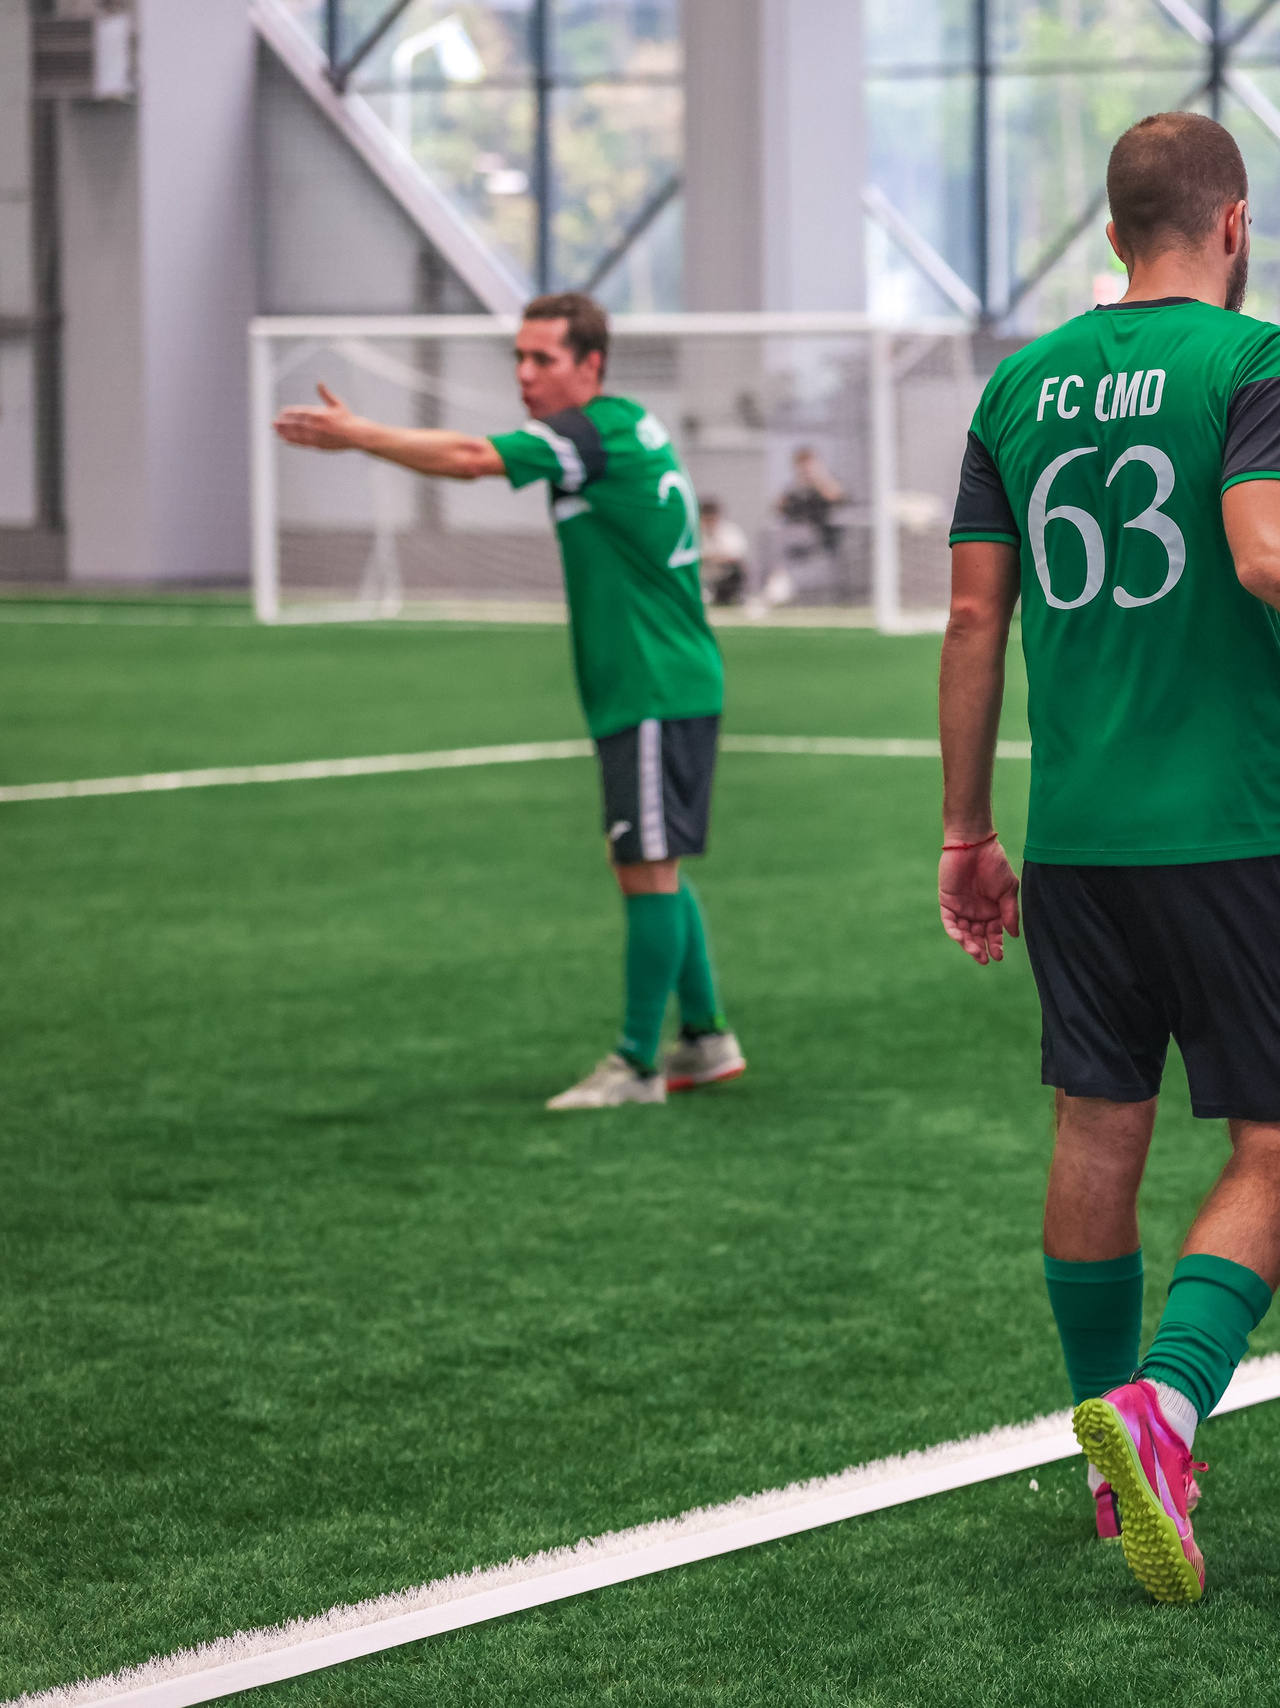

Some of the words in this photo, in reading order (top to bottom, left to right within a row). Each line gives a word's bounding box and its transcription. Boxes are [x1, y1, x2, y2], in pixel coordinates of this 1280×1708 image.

[1036, 374, 1085, 422] FC
[1094, 368, 1166, 422] CMD
[658, 470, 700, 569] 2
[1027, 444, 1187, 610] 63
